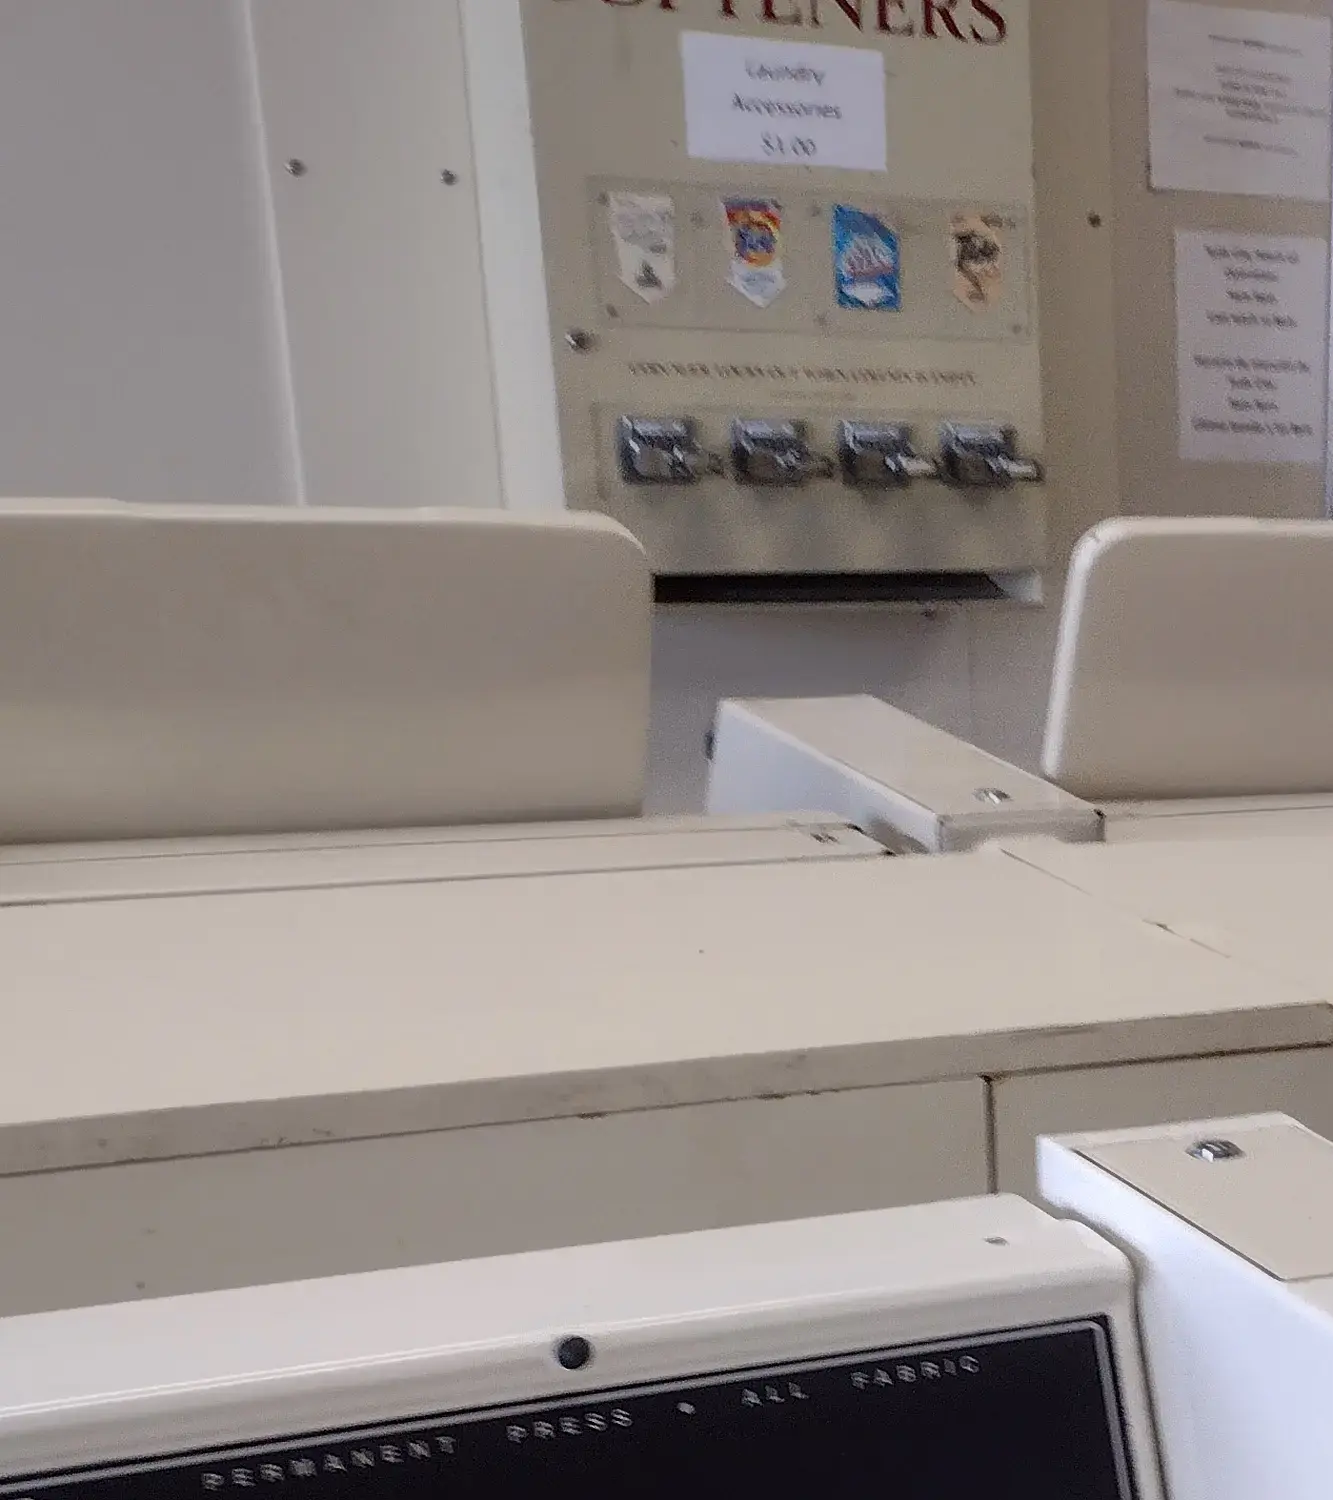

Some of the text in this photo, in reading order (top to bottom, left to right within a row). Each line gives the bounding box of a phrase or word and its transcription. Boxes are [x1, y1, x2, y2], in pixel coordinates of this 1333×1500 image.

[200, 1354, 983, 1491] PERMANENT PRESS ALL FABRIC
